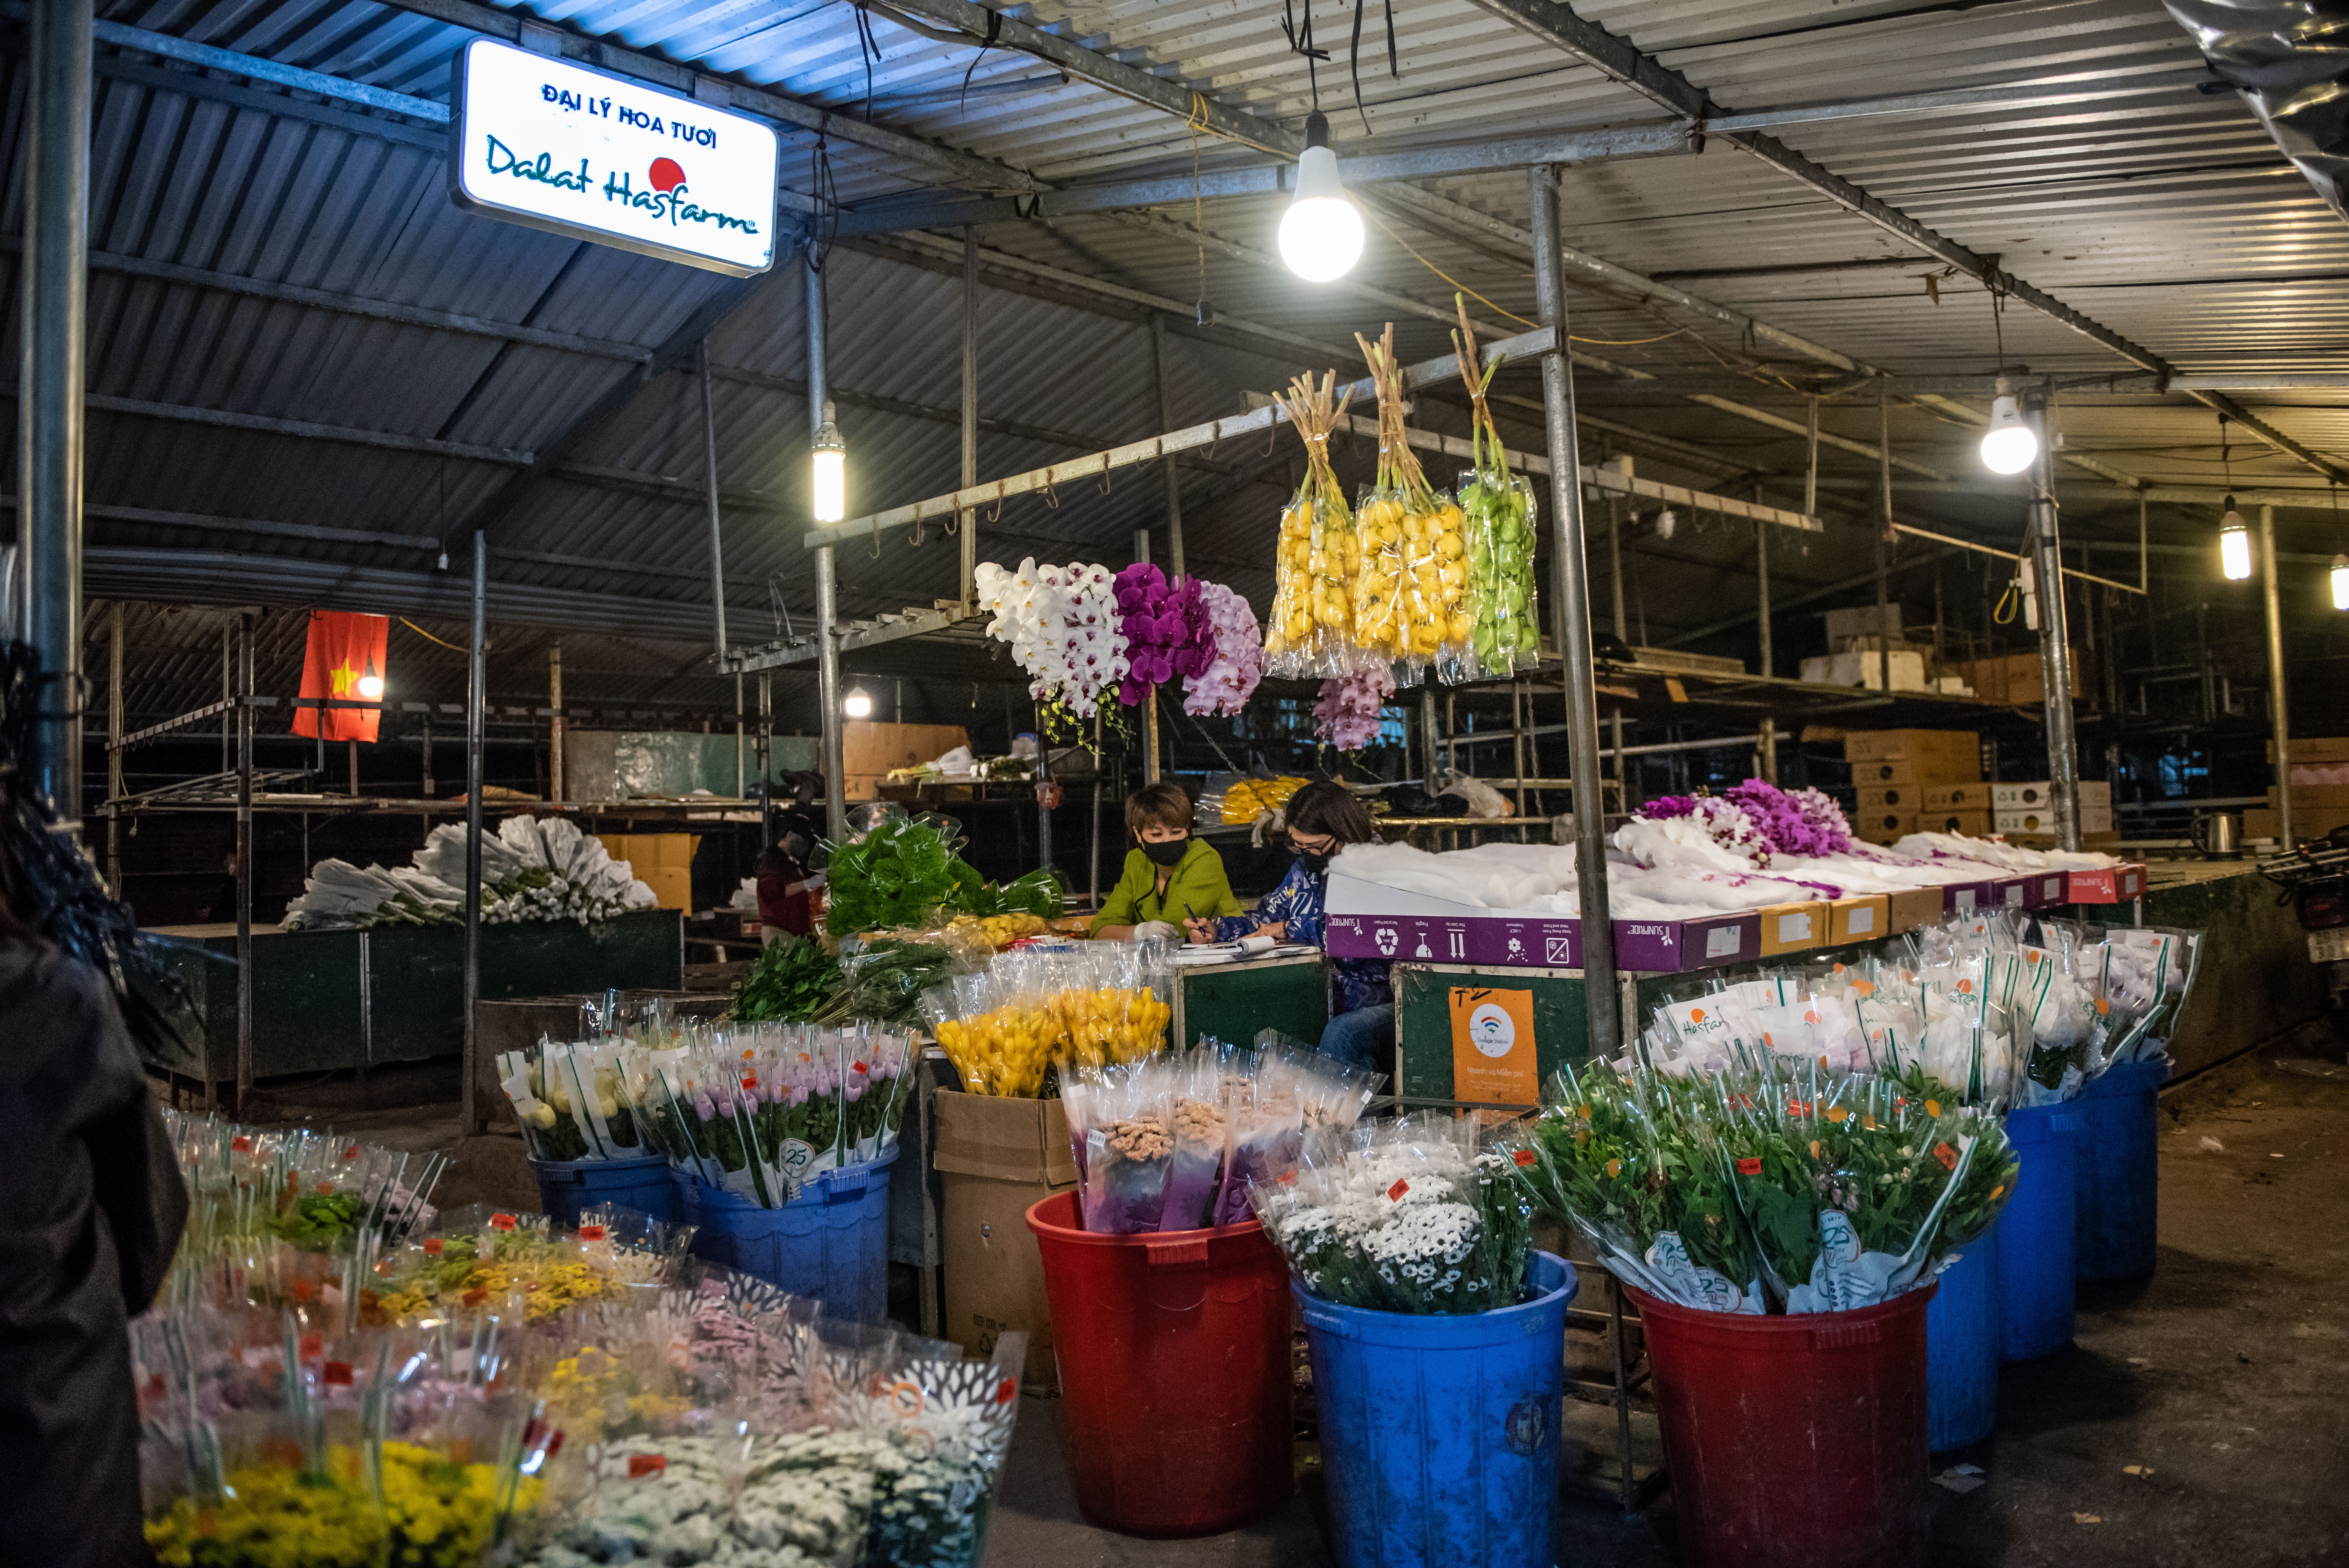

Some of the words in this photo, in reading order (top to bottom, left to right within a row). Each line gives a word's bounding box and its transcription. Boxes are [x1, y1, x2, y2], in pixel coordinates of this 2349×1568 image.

[540, 84, 581, 112] ĐẠI
[589, 97, 611, 118] LÝ
[618, 105, 665, 134] HOA
[671, 121, 716, 150] TƯƠI
[486, 134, 593, 193] Dalat
[604, 171, 760, 234] Hasfarm
[1683, 1016, 1725, 1035] Hasfar
[1467, 1066, 1487, 1075] Nhanh
[785, 1148, 807, 1165] 25
